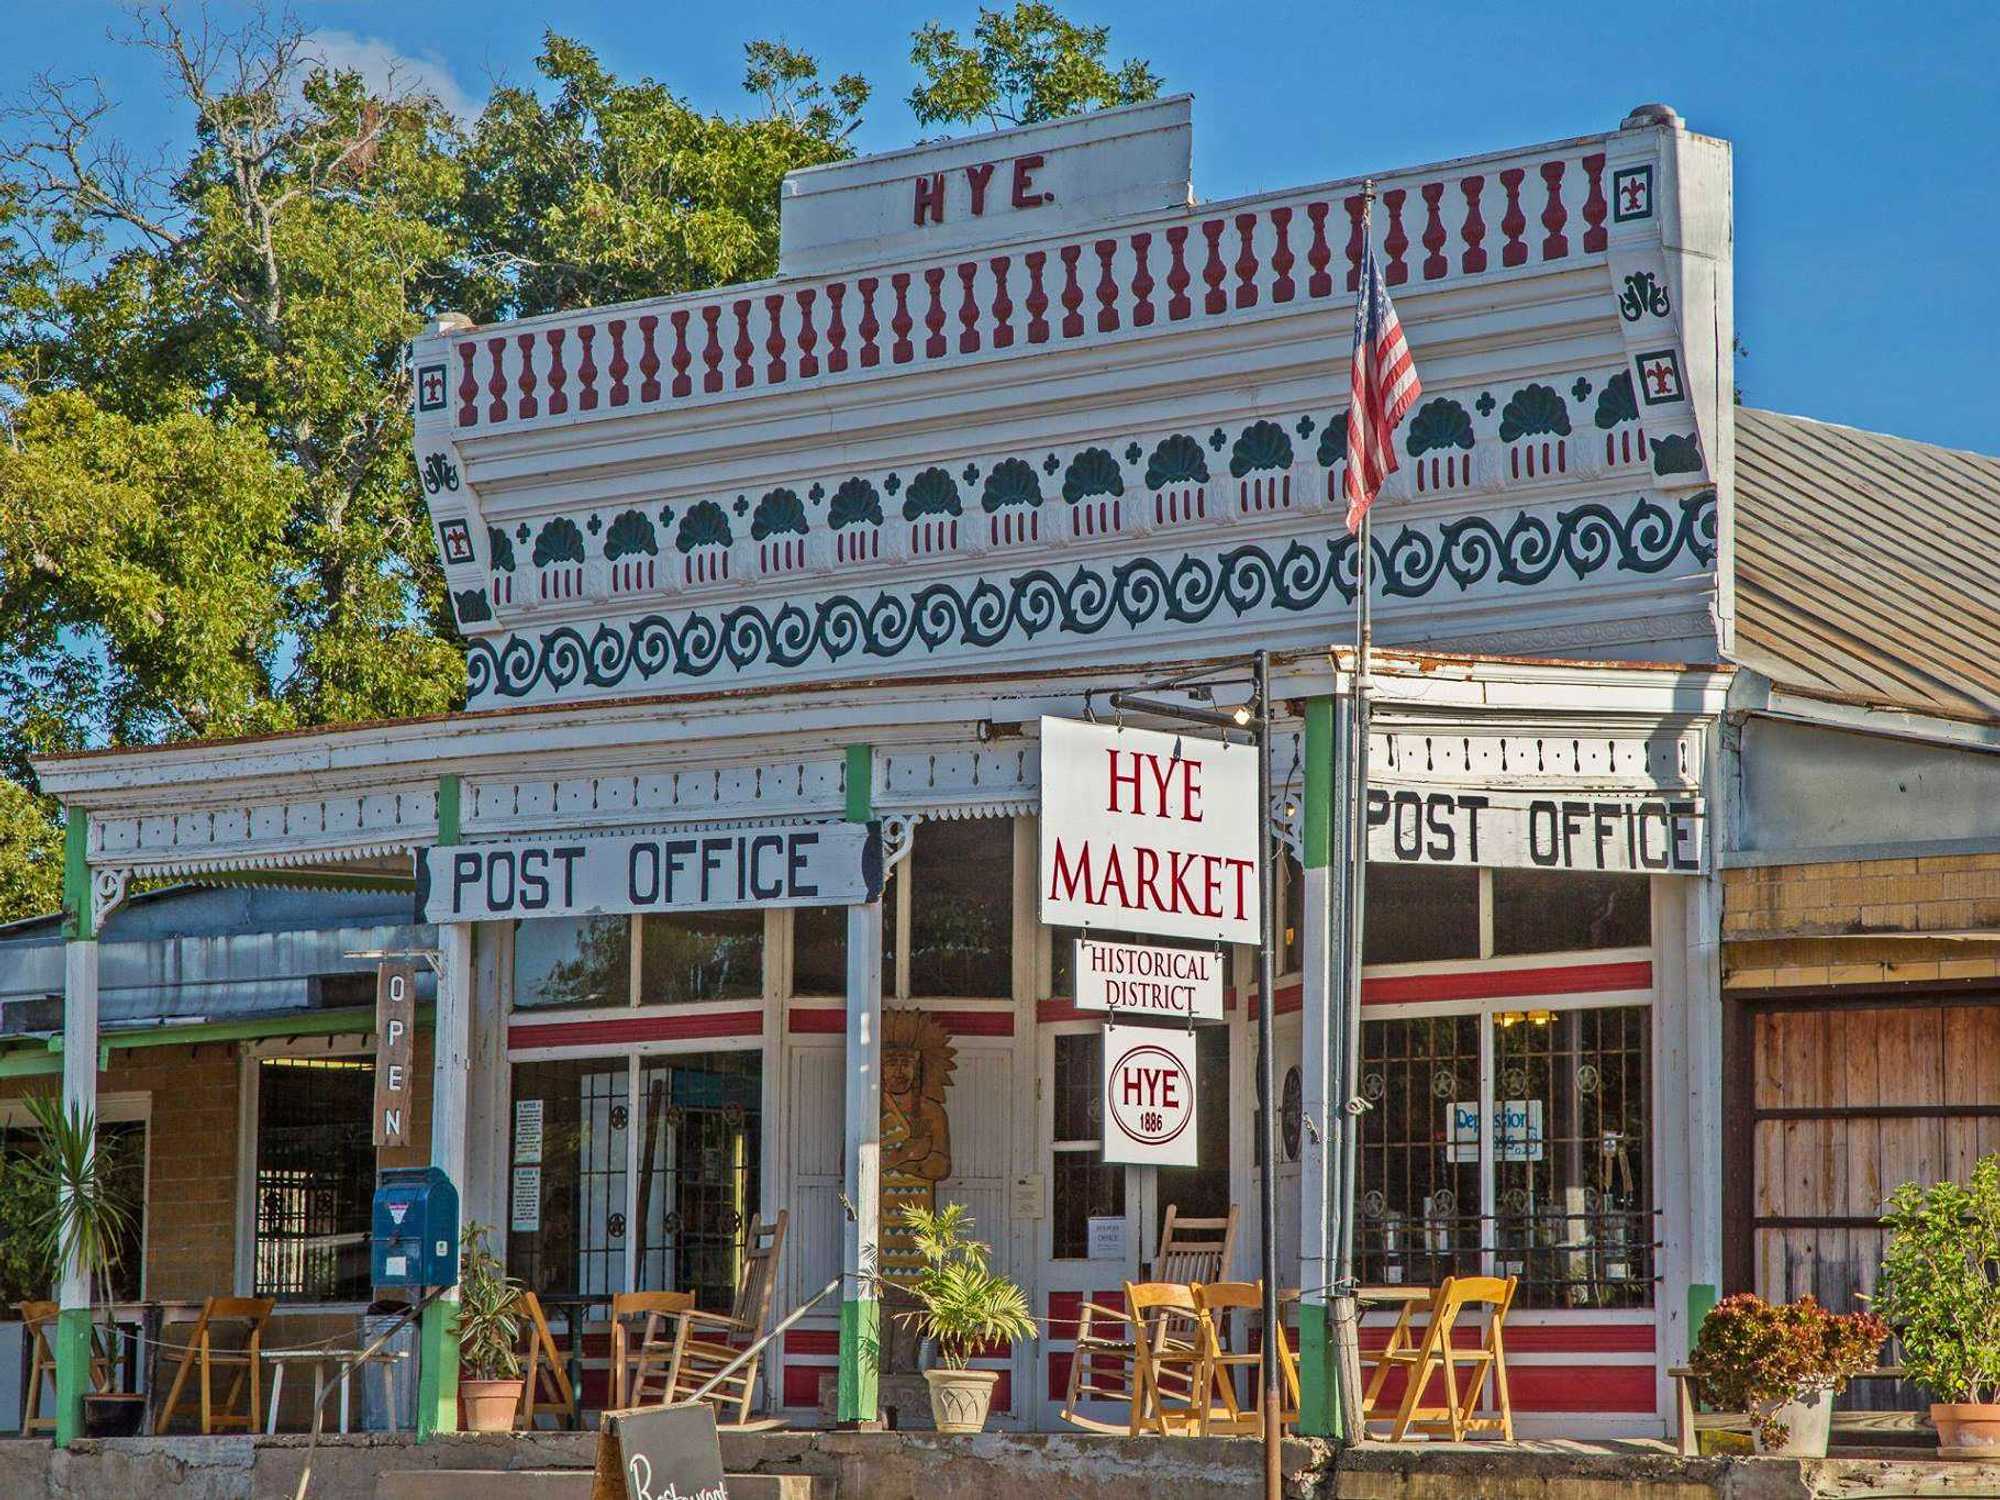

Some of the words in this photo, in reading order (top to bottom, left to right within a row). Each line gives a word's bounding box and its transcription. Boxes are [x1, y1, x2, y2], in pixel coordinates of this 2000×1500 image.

[1106, 748, 1204, 823] HYE
[1367, 788, 1489, 863] POST
[1530, 799, 1699, 870] OFFICE
[452, 846, 586, 914] POST
[628, 832, 820, 906] OFFICE
[1047, 836, 1255, 921] MARKET
[1091, 946, 1209, 982] HISTORICAL
[1105, 979, 1197, 1011] DISTRICT
[384, 974, 405, 1136] OPEN
[1123, 1066, 1180, 1109] HYE
[1140, 1111, 1163, 1133] 1886
